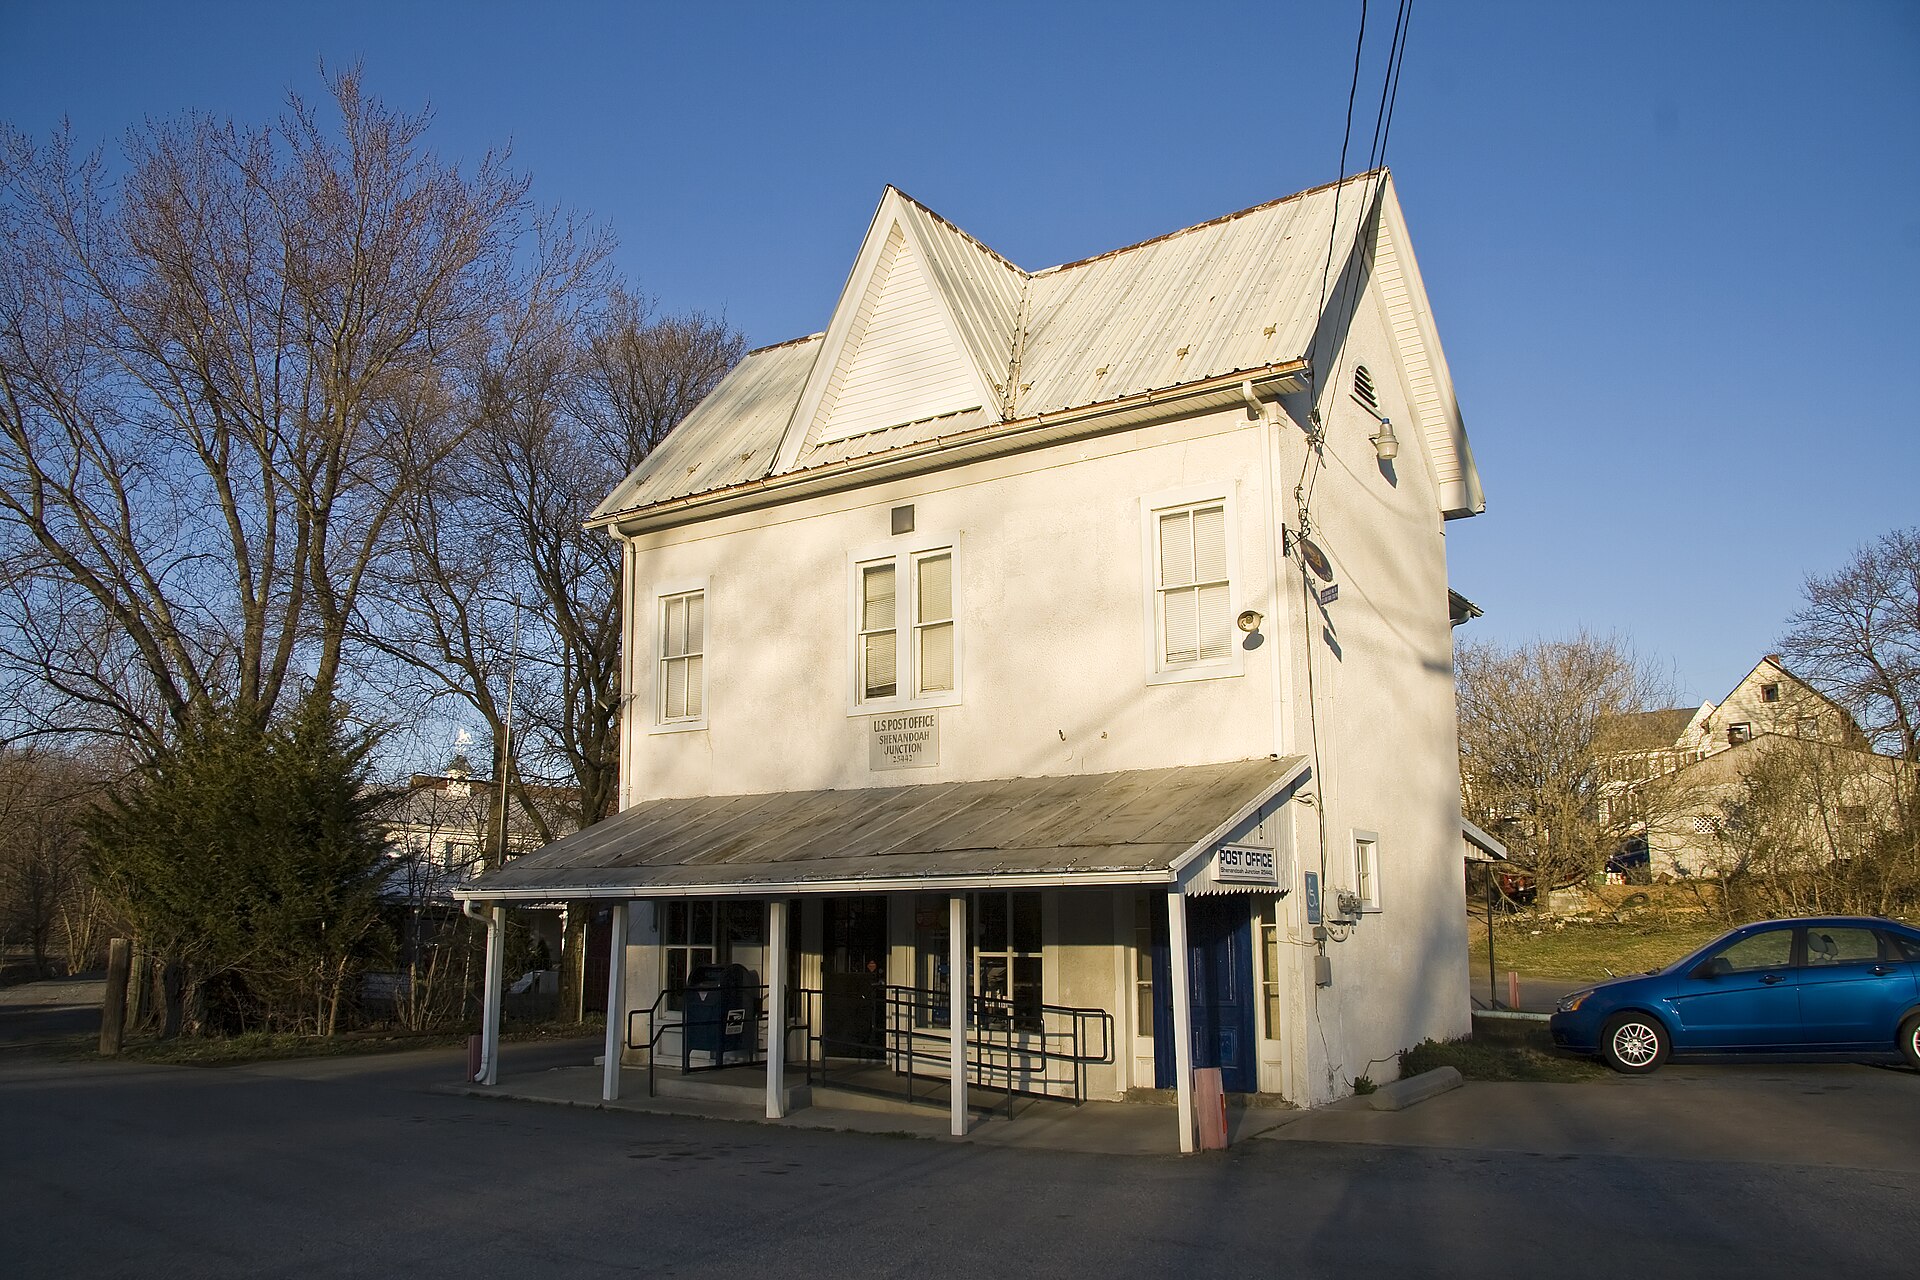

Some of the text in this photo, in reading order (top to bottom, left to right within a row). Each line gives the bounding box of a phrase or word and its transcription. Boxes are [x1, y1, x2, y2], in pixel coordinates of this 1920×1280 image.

[888, 718, 907, 731] POST
[908, 715, 934, 729] OFFICE
[879, 731, 930, 745] SHENANDOAH
[884, 743, 922, 755] JUNCTION
[893, 754, 912, 763] 25442
[1220, 850, 1272, 867] POST OFFICE
